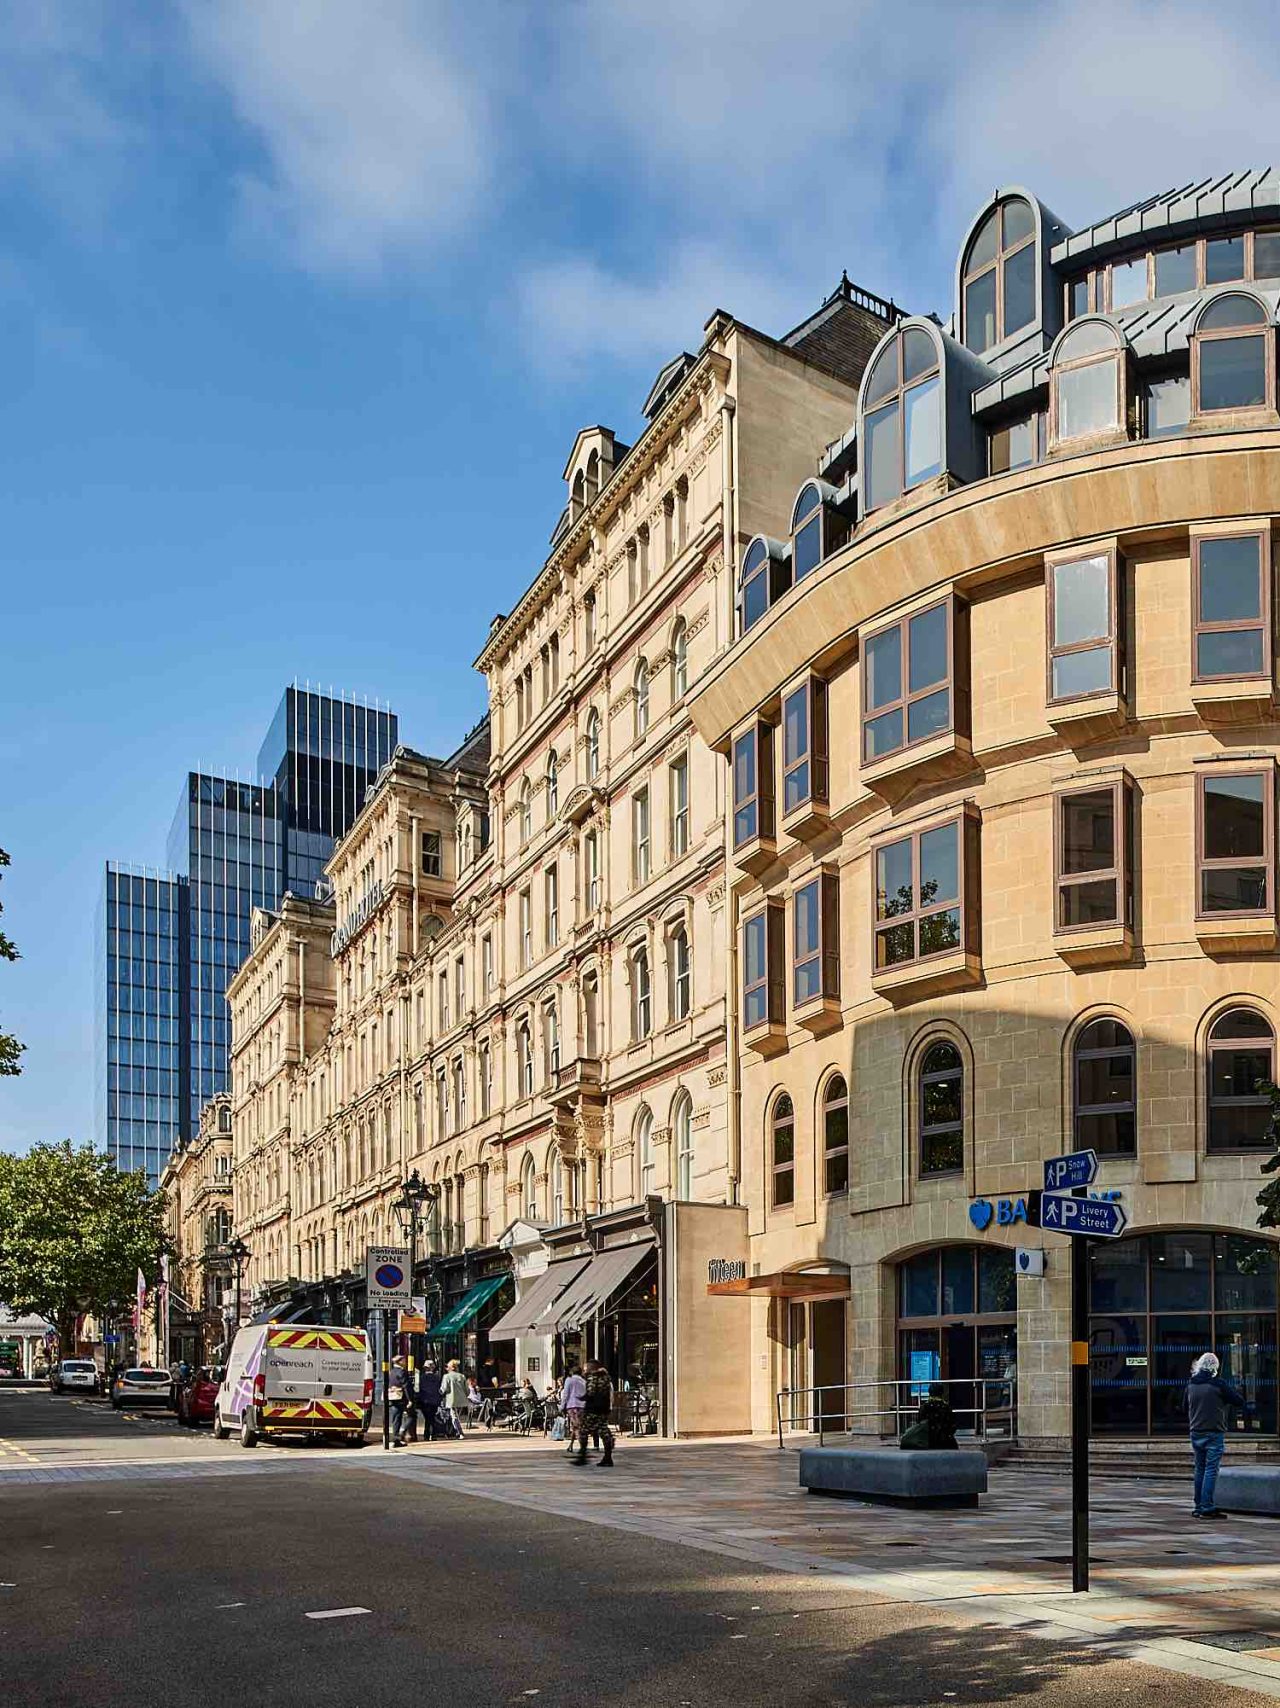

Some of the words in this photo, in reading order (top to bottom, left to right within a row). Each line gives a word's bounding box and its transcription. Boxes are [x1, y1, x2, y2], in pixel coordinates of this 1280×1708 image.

[1068, 1159, 1086, 1170] Snow
[1056, 1161, 1067, 1187] P
[1071, 1170, 1083, 1181] Hill
[1061, 1200, 1078, 1226] P
[1081, 1204, 1109, 1219] Livery
[1080, 1216, 1109, 1229] Street
[370, 1248, 409, 1256] Controlled
[375, 1255, 403, 1263] ZONE
[708, 1258, 746, 1284] fifteen
[270, 1360, 314, 1368] openreach
